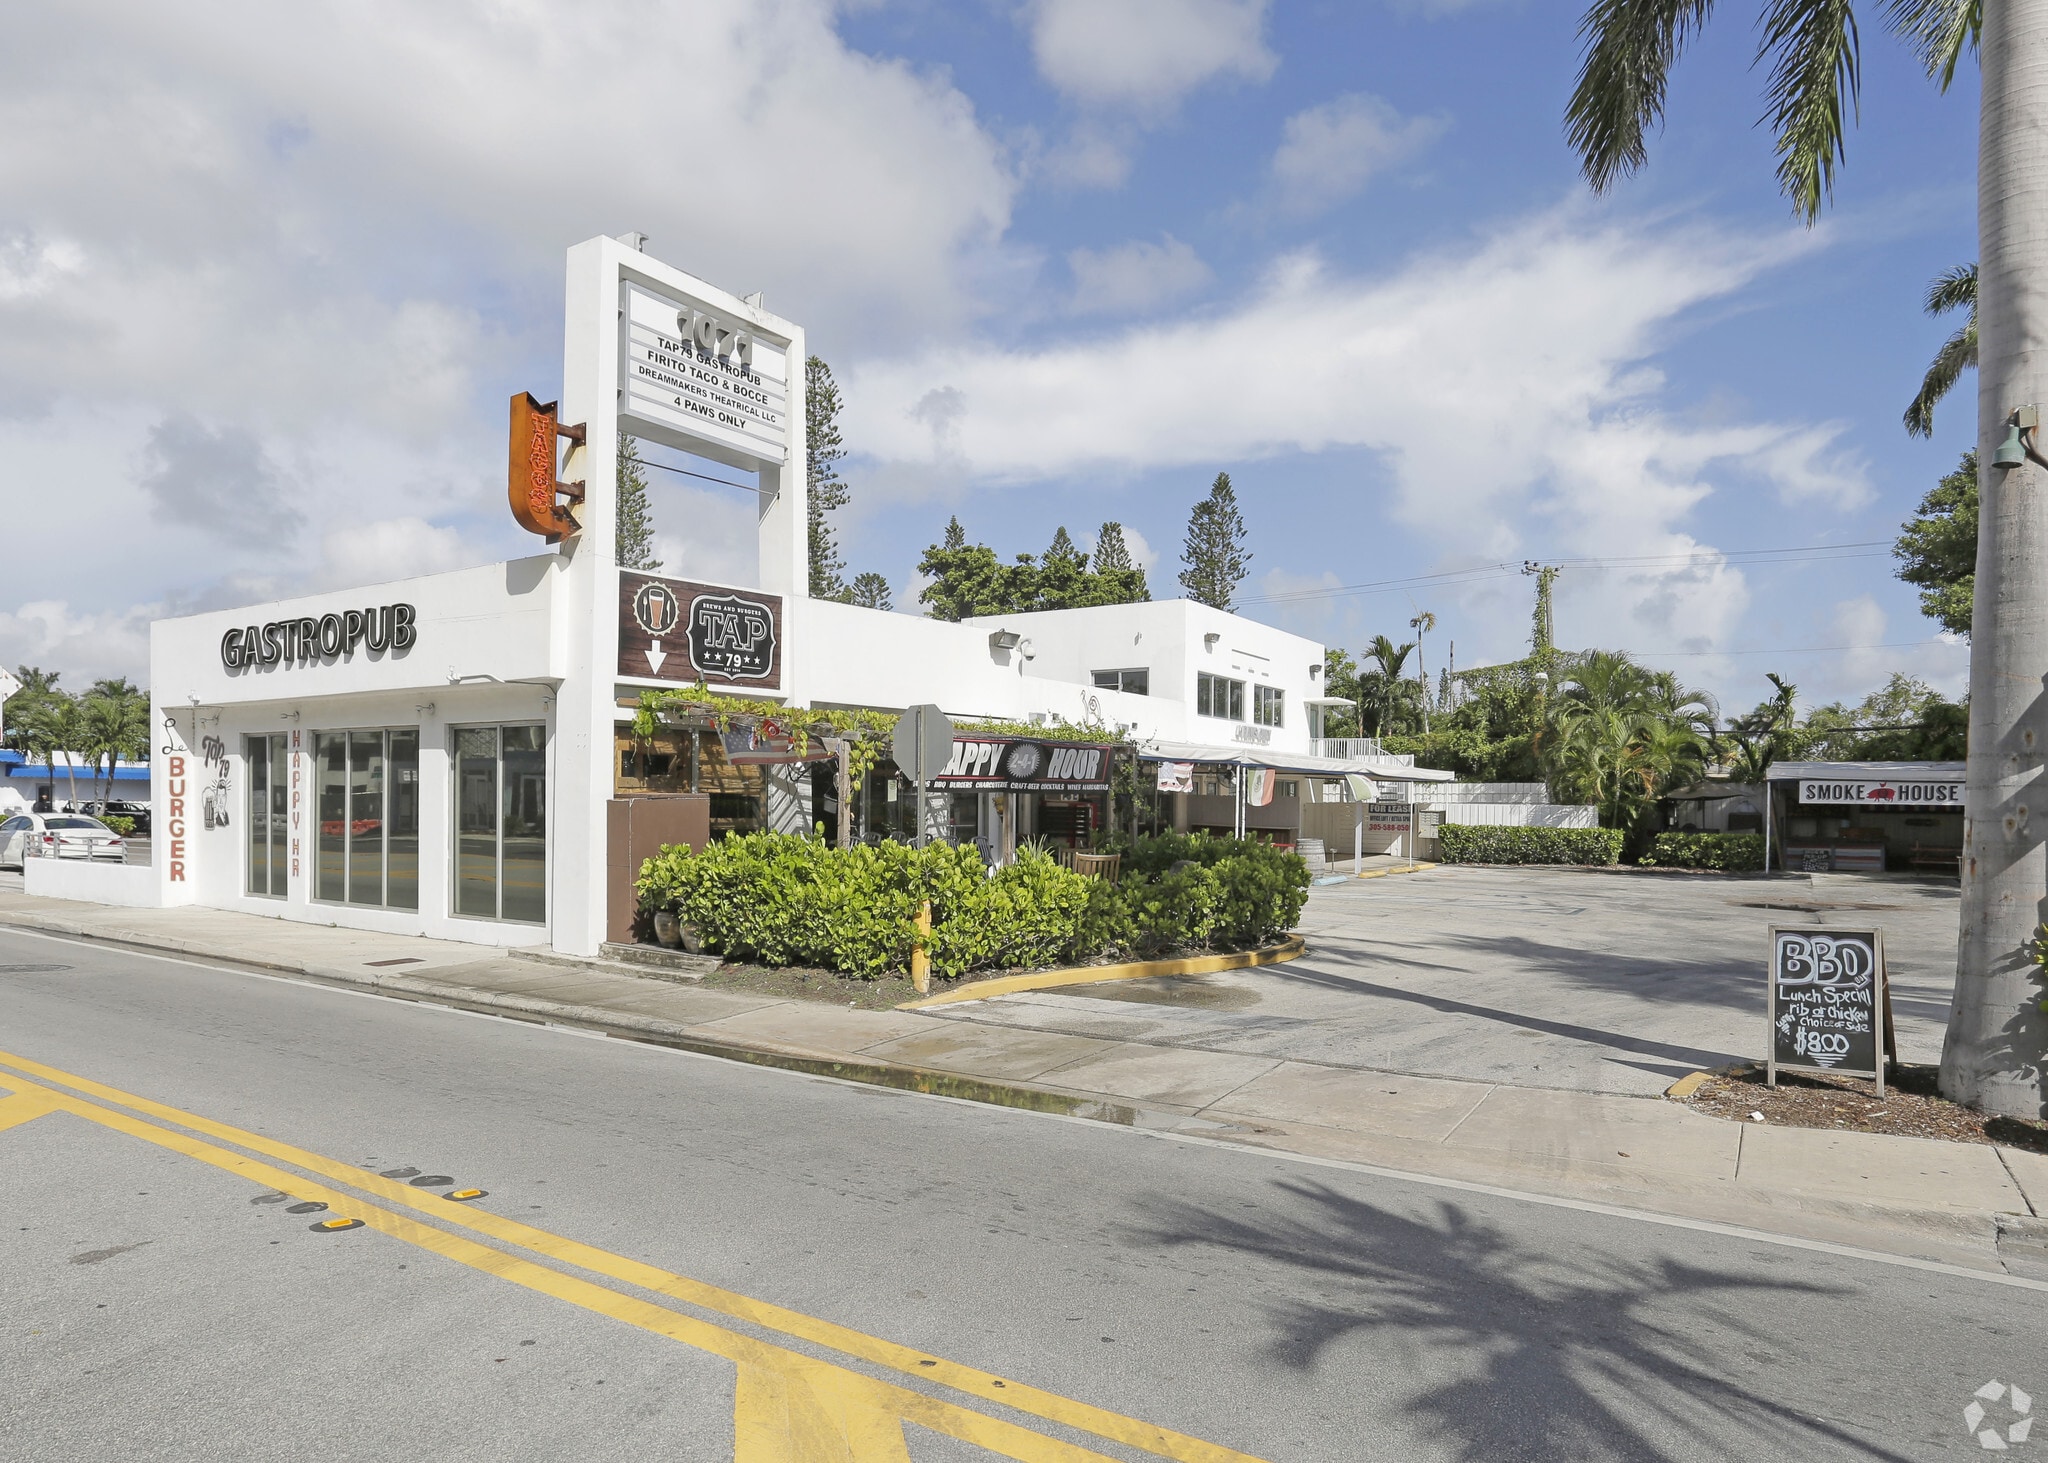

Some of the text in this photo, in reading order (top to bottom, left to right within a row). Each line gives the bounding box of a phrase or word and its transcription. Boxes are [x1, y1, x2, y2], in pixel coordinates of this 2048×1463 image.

[677, 307, 753, 366] 1071
[647, 350, 768, 405] FIRITO TACO & BOCCE
[657, 337, 761, 386] TAP79 GASTROPUB
[638, 365, 776, 423] DREAMMAKERS THEATRICAL LLC
[674, 396, 746, 429] 4 PAWS ONLY
[702, 602, 721, 611] BREWS
[221, 603, 418, 669] GASTROPUB
[699, 610, 768, 652] TAP
[725, 653, 742, 667] 79
[219, 759, 230, 778] 79
[940, 741, 1100, 780] APPY HOUR
[1009, 753, 1036, 769] 2-4-1
[933, 781, 947, 789] BBQ
[1805, 783, 1959, 801] SMOKE HOUSE
[168, 756, 187, 882] BURGER
[291, 729, 301, 878] HAPPY HR
[1370, 804, 1387, 813] FOR
[1776, 933, 1874, 989] BBQ
[1779, 985, 1872, 1007] Lunch Special
[1789, 1003, 1810, 1016] rib
[1812, 1006, 1827, 1017] or
[1794, 1026, 1850, 1056] $8.00
